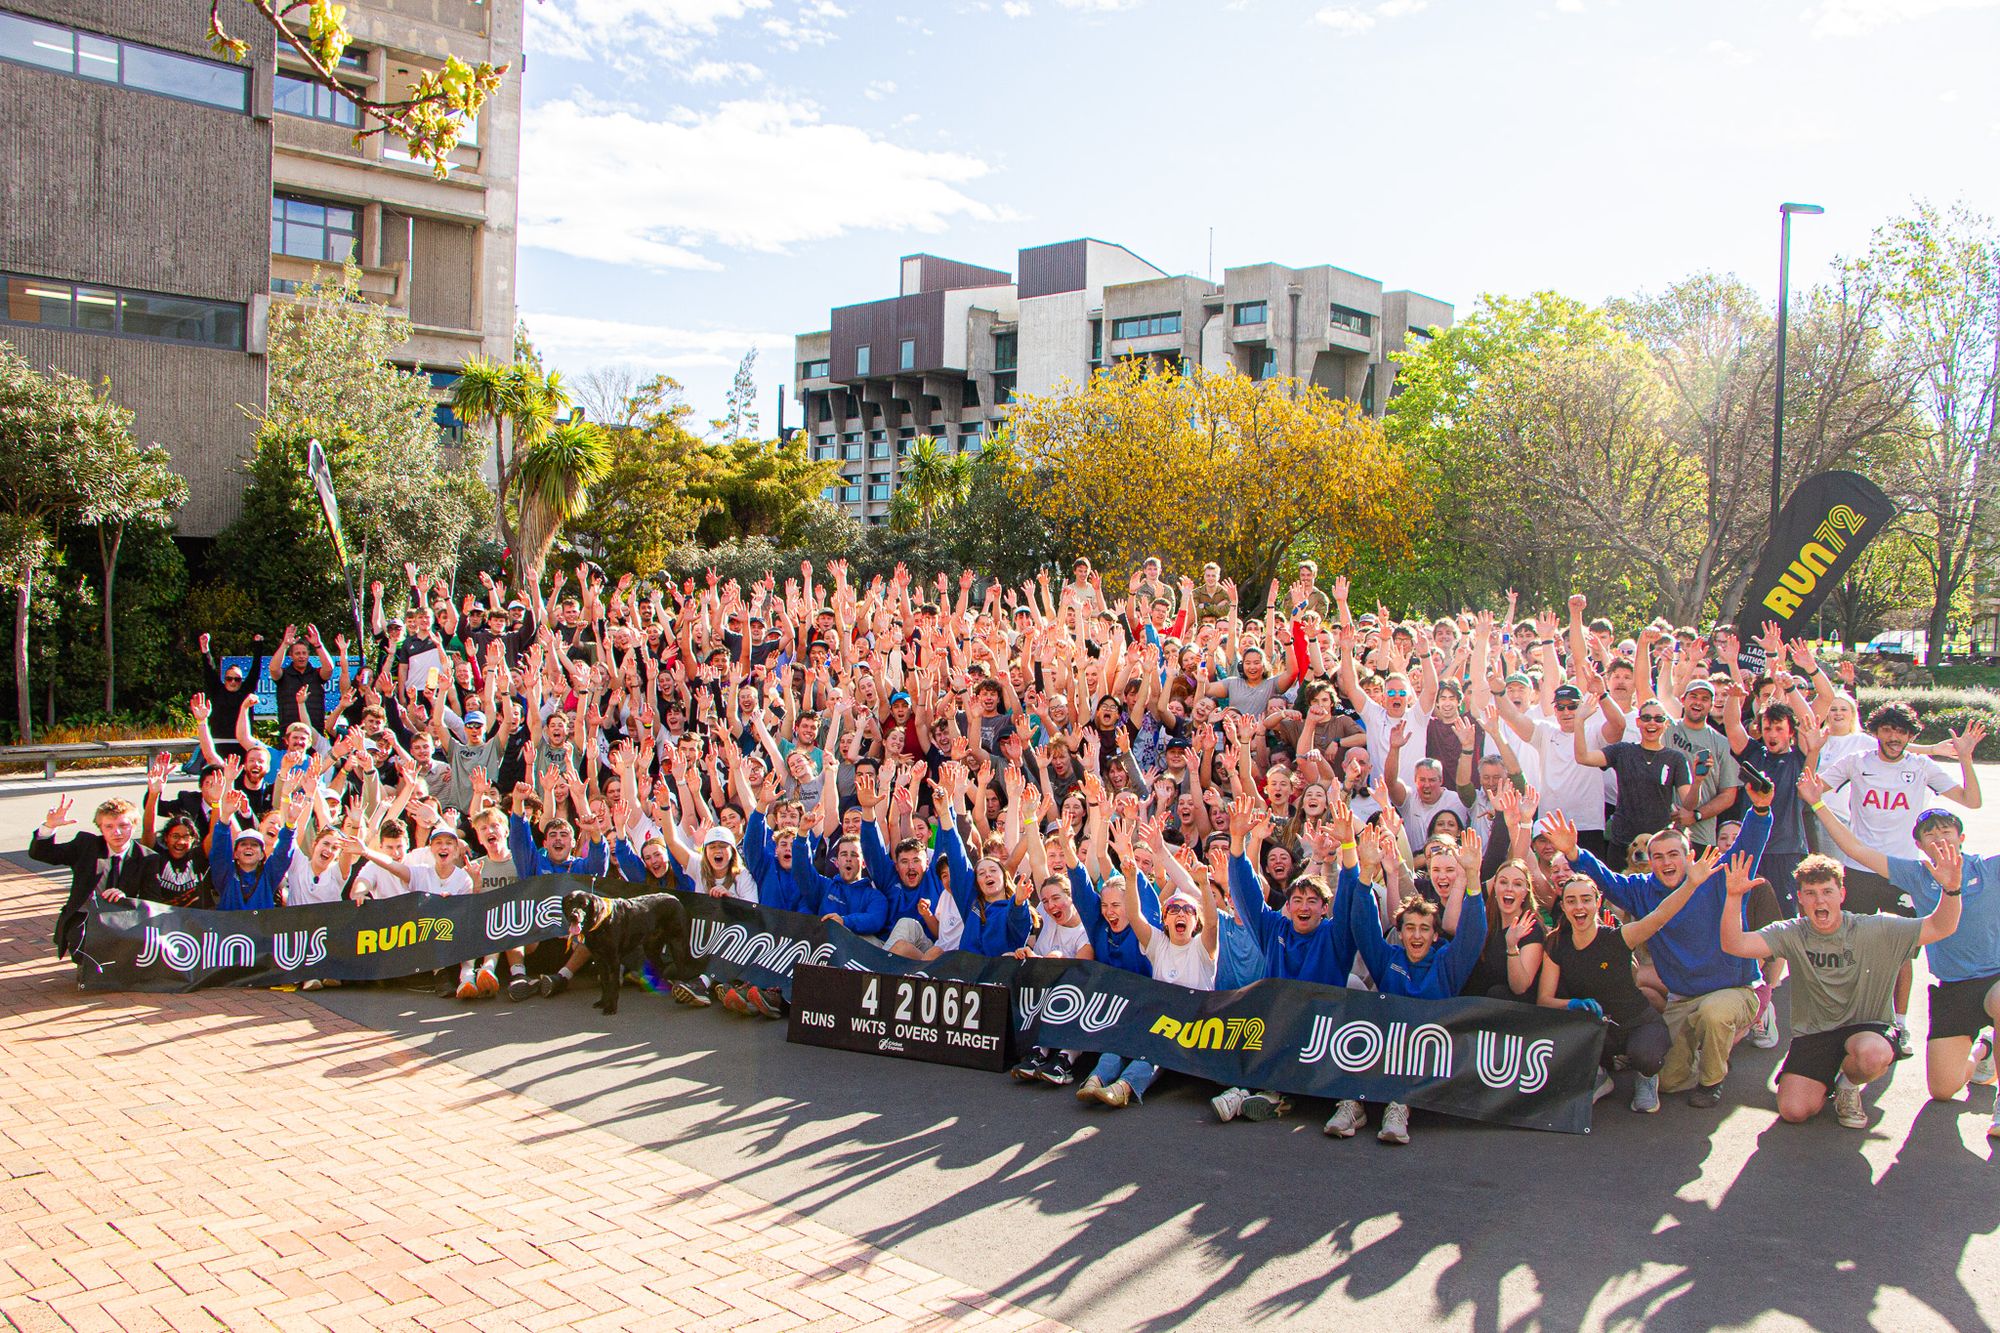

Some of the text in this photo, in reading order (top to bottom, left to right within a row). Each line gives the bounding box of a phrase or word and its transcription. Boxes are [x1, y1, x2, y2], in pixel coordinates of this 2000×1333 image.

[1762, 504, 1867, 619] RUN72
[1738, 653, 1765, 666] WITHOU
[1862, 789, 1910, 810] AIA
[356, 917, 453, 955] RUN72
[1019, 984, 1129, 1032] YOU
[1150, 1014, 1265, 1051] RUN72
[1299, 1015, 1453, 1078] JOIN
[1476, 1030, 1554, 1094] US
[861, 978, 878, 1015] 4
[801, 1010, 1000, 1050] RUNS WKTS OVERS TARGET
